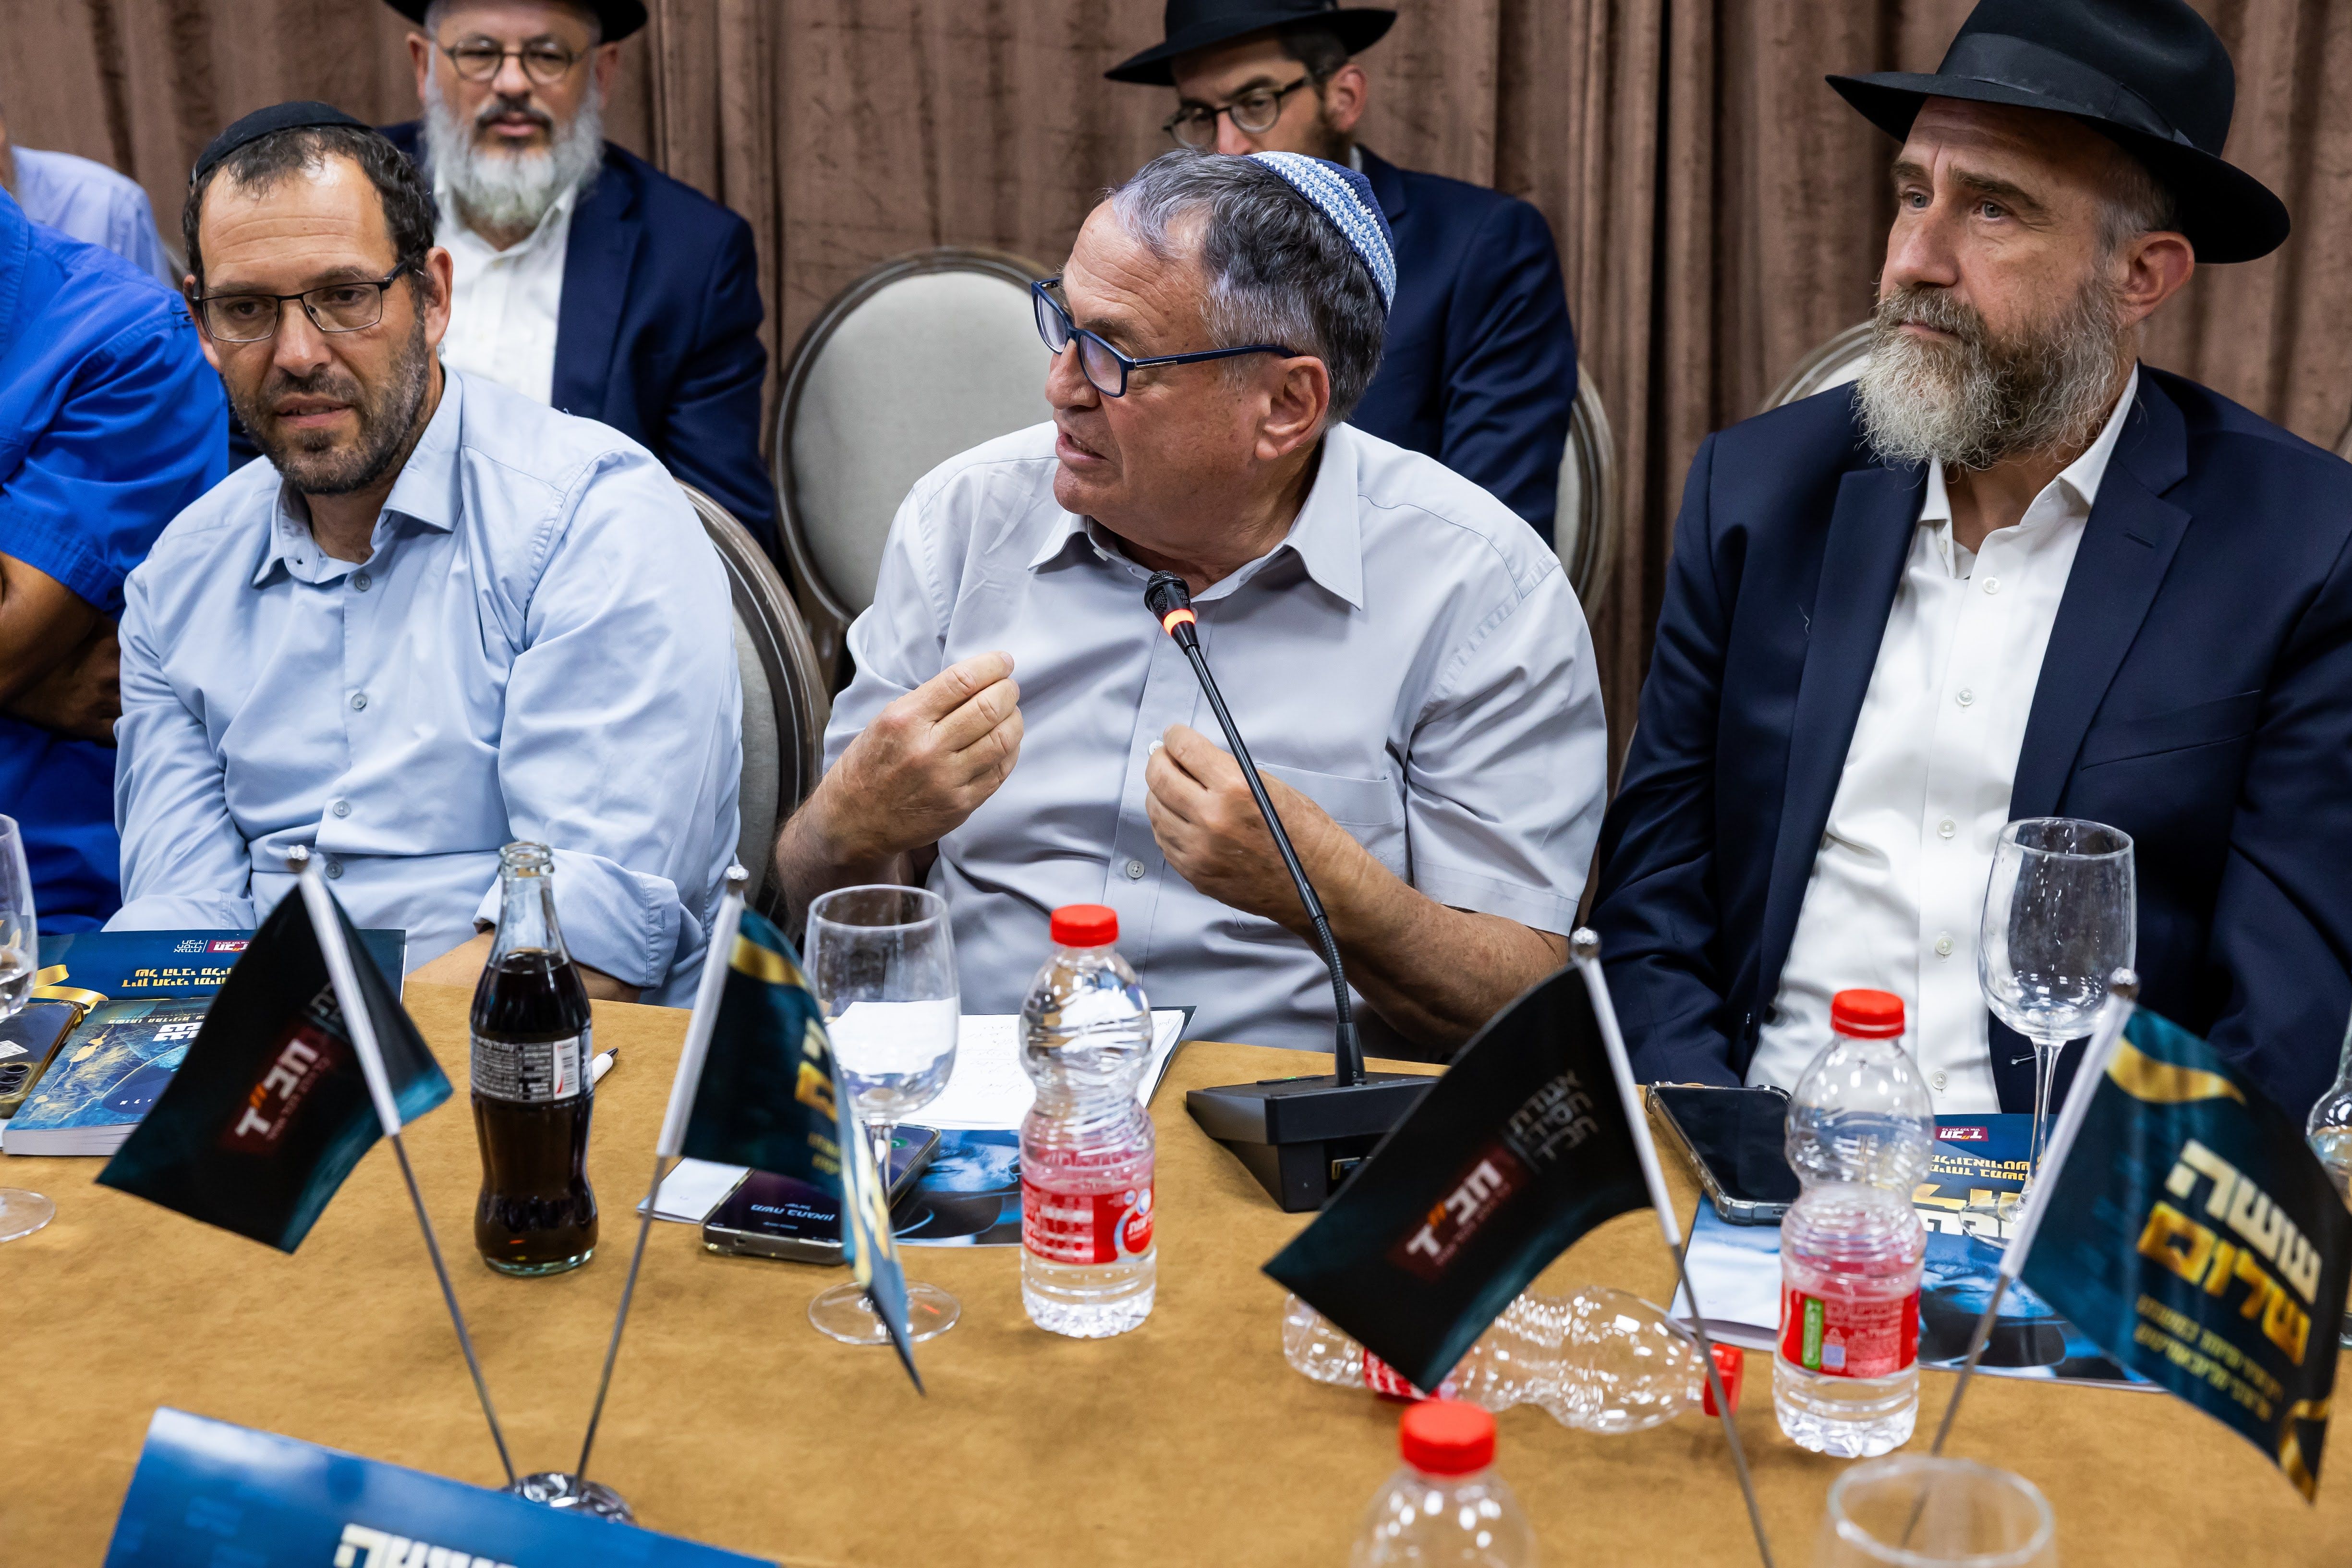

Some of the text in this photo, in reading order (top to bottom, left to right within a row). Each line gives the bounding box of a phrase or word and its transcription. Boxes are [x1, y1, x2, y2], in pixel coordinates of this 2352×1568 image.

[135, 967, 231, 978] של הרבי מליו
[121, 979, 148, 987] דיון
[153, 978, 189, 986] חגיגי
[1980, 1169, 2027, 1181] במשנ
[2137, 1201, 2312, 1367] שלום
